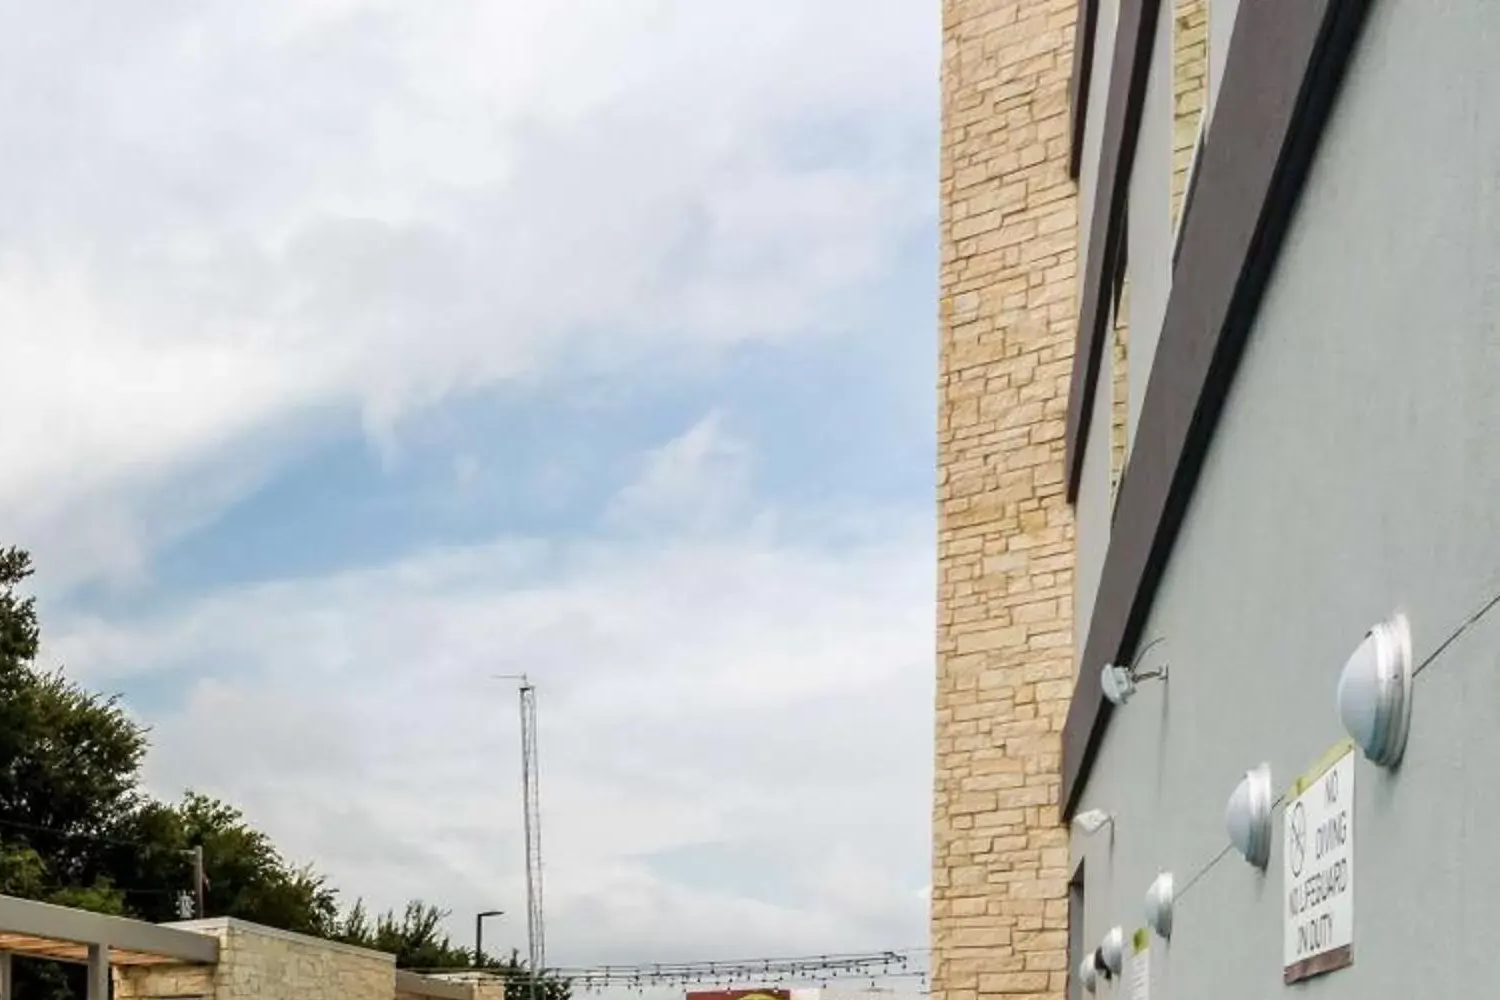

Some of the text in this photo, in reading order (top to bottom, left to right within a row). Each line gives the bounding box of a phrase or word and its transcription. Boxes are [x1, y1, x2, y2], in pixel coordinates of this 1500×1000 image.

[1325, 769, 1339, 803] NO
[1315, 810, 1347, 860] DIVING
[1299, 857, 1348, 913] LIFEGUARD
